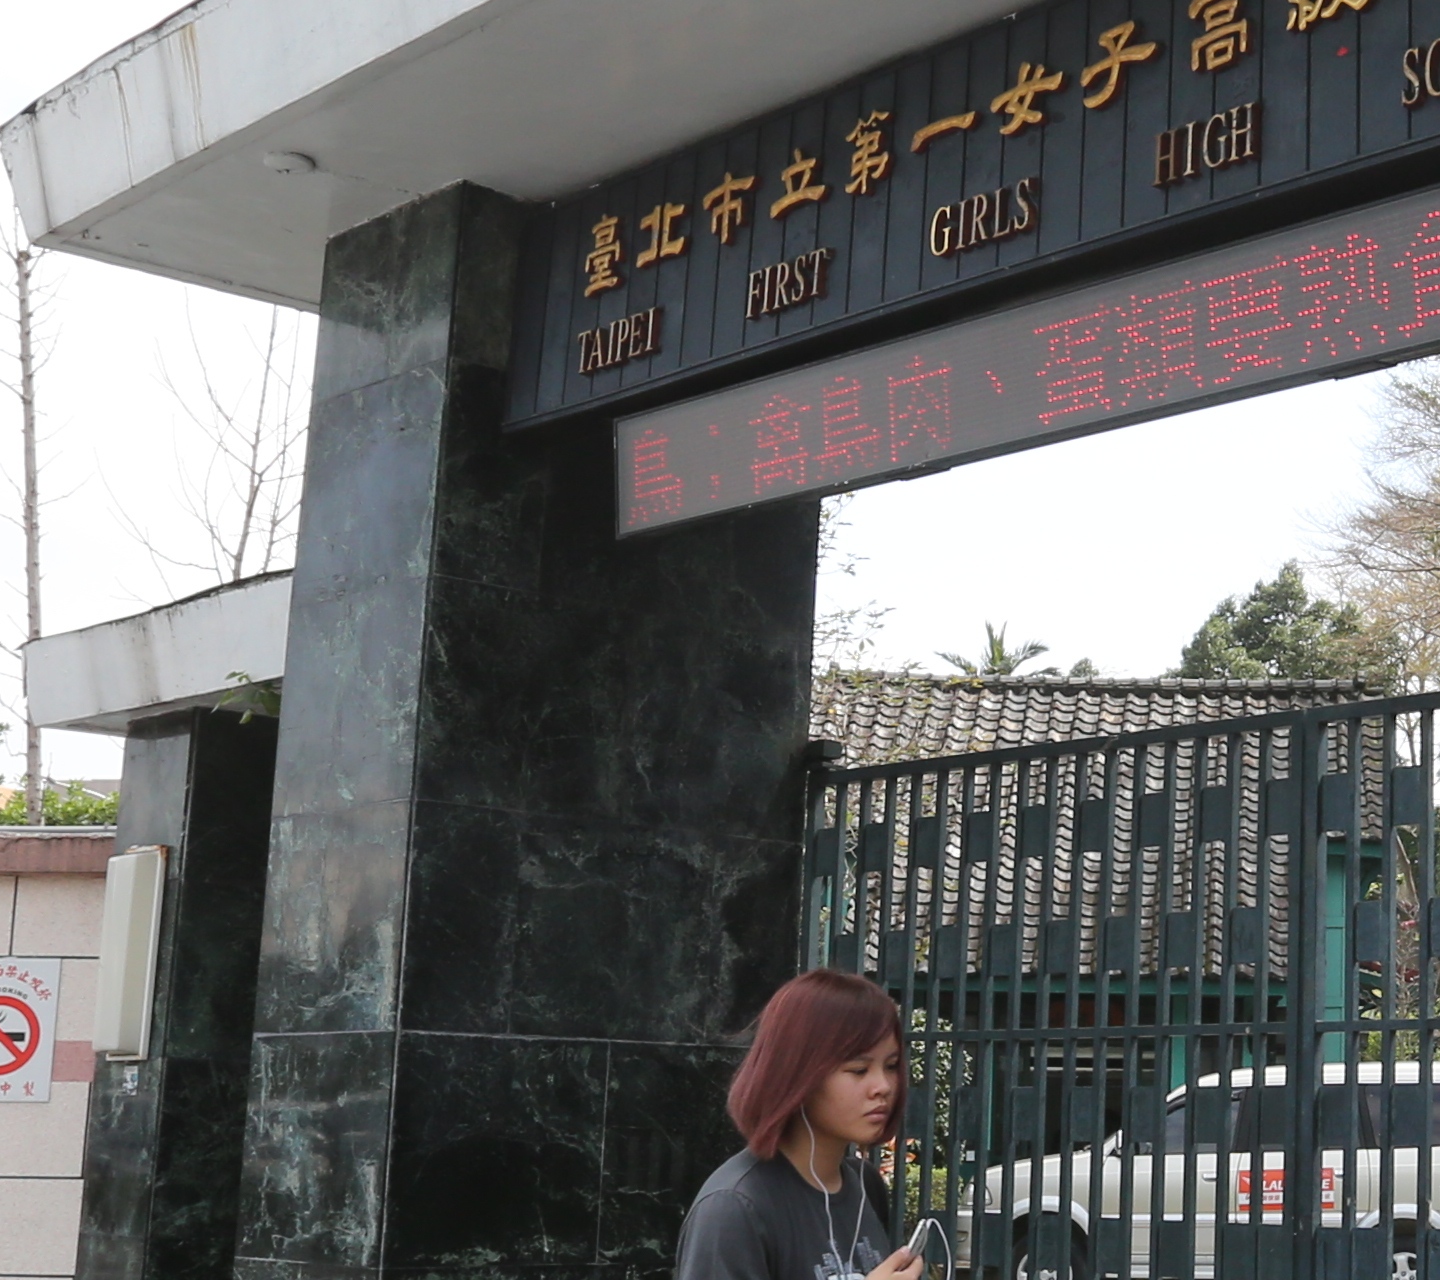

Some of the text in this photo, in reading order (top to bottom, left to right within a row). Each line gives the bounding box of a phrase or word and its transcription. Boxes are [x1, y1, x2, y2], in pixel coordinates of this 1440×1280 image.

[578, 307, 661, 374] TAIPEI
[745, 248, 831, 319] FIRST
[930, 177, 1038, 257] GIRLS
[1153, 101, 1257, 187] HIGH
